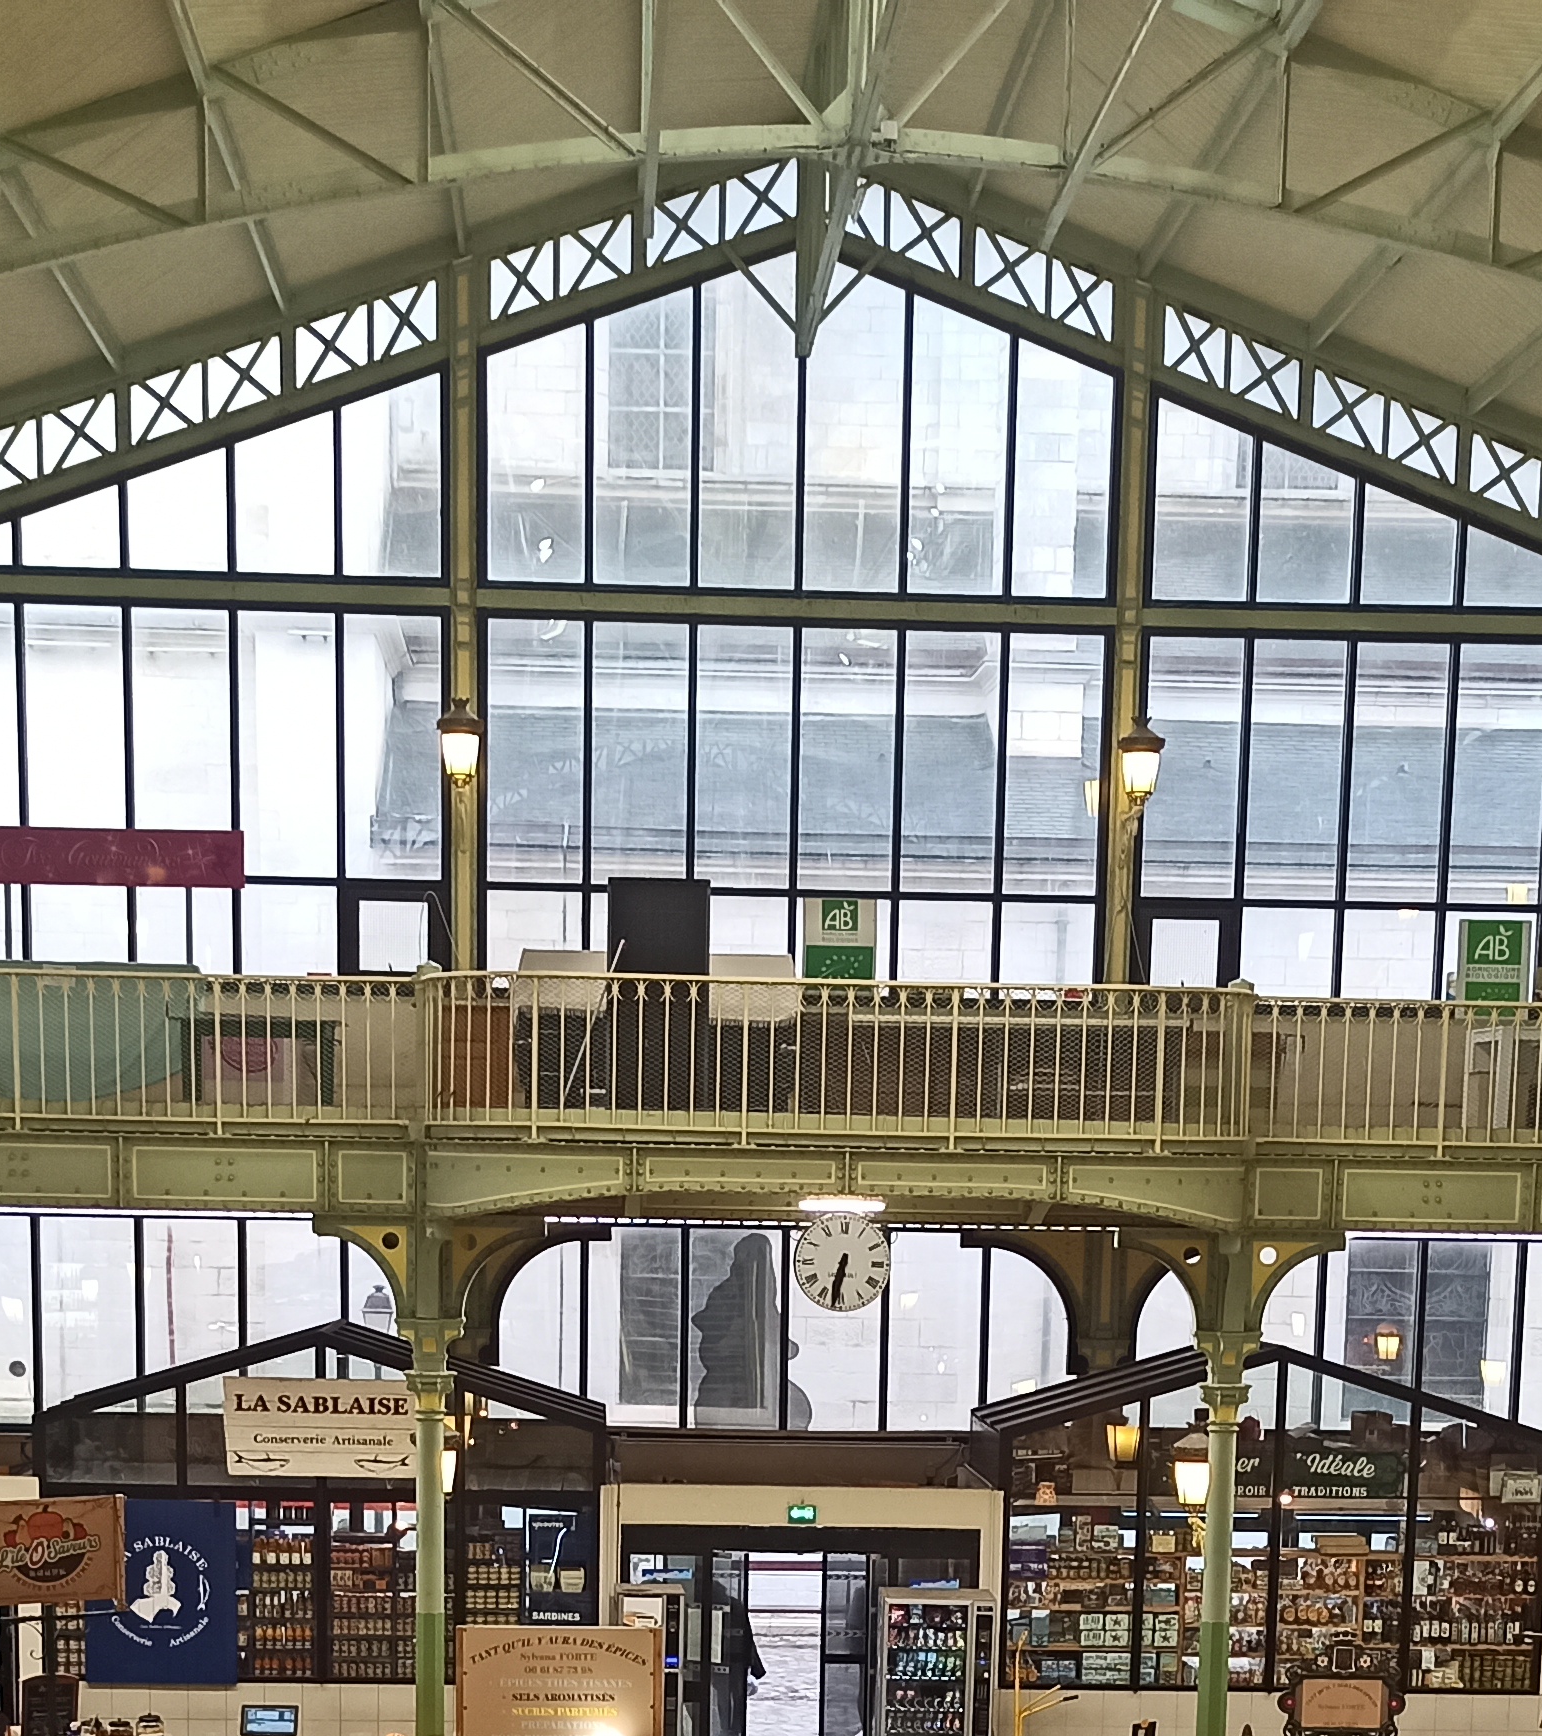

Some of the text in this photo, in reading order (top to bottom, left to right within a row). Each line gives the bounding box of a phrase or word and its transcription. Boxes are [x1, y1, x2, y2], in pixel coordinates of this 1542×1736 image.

[824, 908, 853, 930] AB
[1473, 934, 1510, 961] AB
[234, 1393, 409, 1416] LA SABLAISE
[253, 1433, 394, 1447] Conserverie Artisanale
[1293, 1485, 1368, 1497] TRADITIONS
[133, 1535, 209, 1571] SABLAISE
[532, 1611, 581, 1622] SARDINES
[111, 1615, 209, 1648] Conserverie Artisanale
[469, 1645, 502, 1665] TANT
[548, 1635, 577, 1647] AURA
[579, 1637, 604, 1651] DES
[559, 1652, 598, 1662] FORTE
[581, 1678, 633, 1689] TISANES
[511, 1692, 540, 1702] SELS
